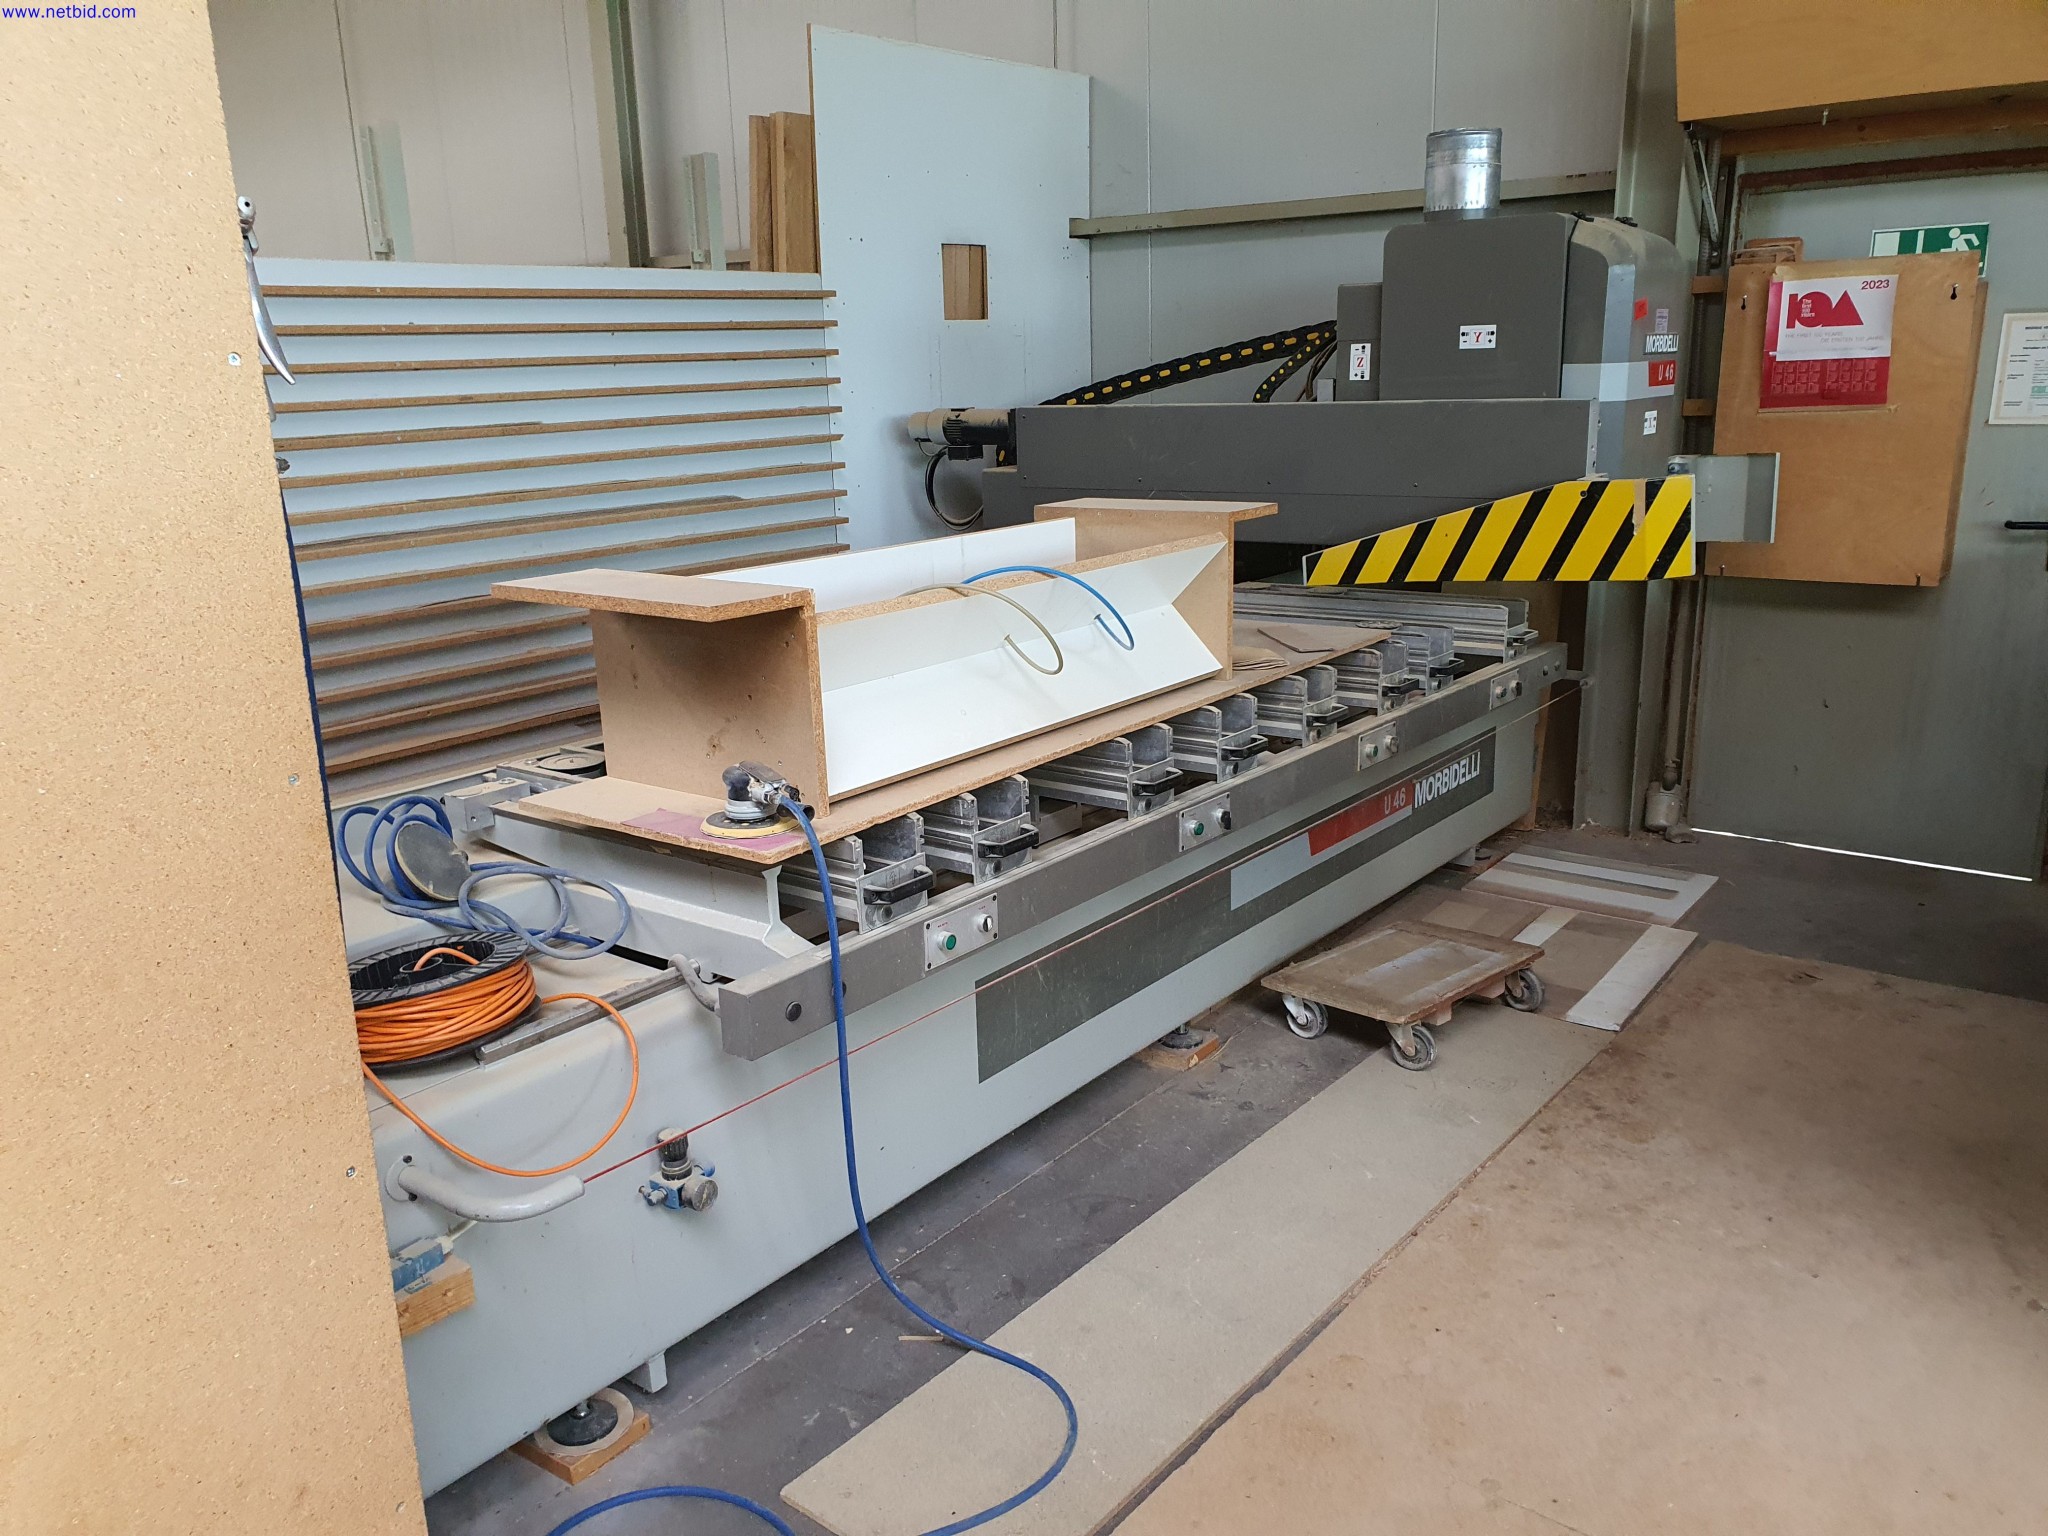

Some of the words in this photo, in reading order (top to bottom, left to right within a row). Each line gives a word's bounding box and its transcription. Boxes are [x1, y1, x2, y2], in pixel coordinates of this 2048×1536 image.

[1861, 279, 1890, 290] 2023
[1473, 331, 1483, 343] Y
[1645, 335, 1679, 353] MORBIDELLI
[1356, 357, 1364, 368] Z
[1658, 364, 1664, 381] U
[1665, 363, 1674, 380] 46
[1384, 794, 1391, 815] U
[1393, 788, 1406, 809] 46
[1414, 751, 1481, 809] MORBIDELLI
